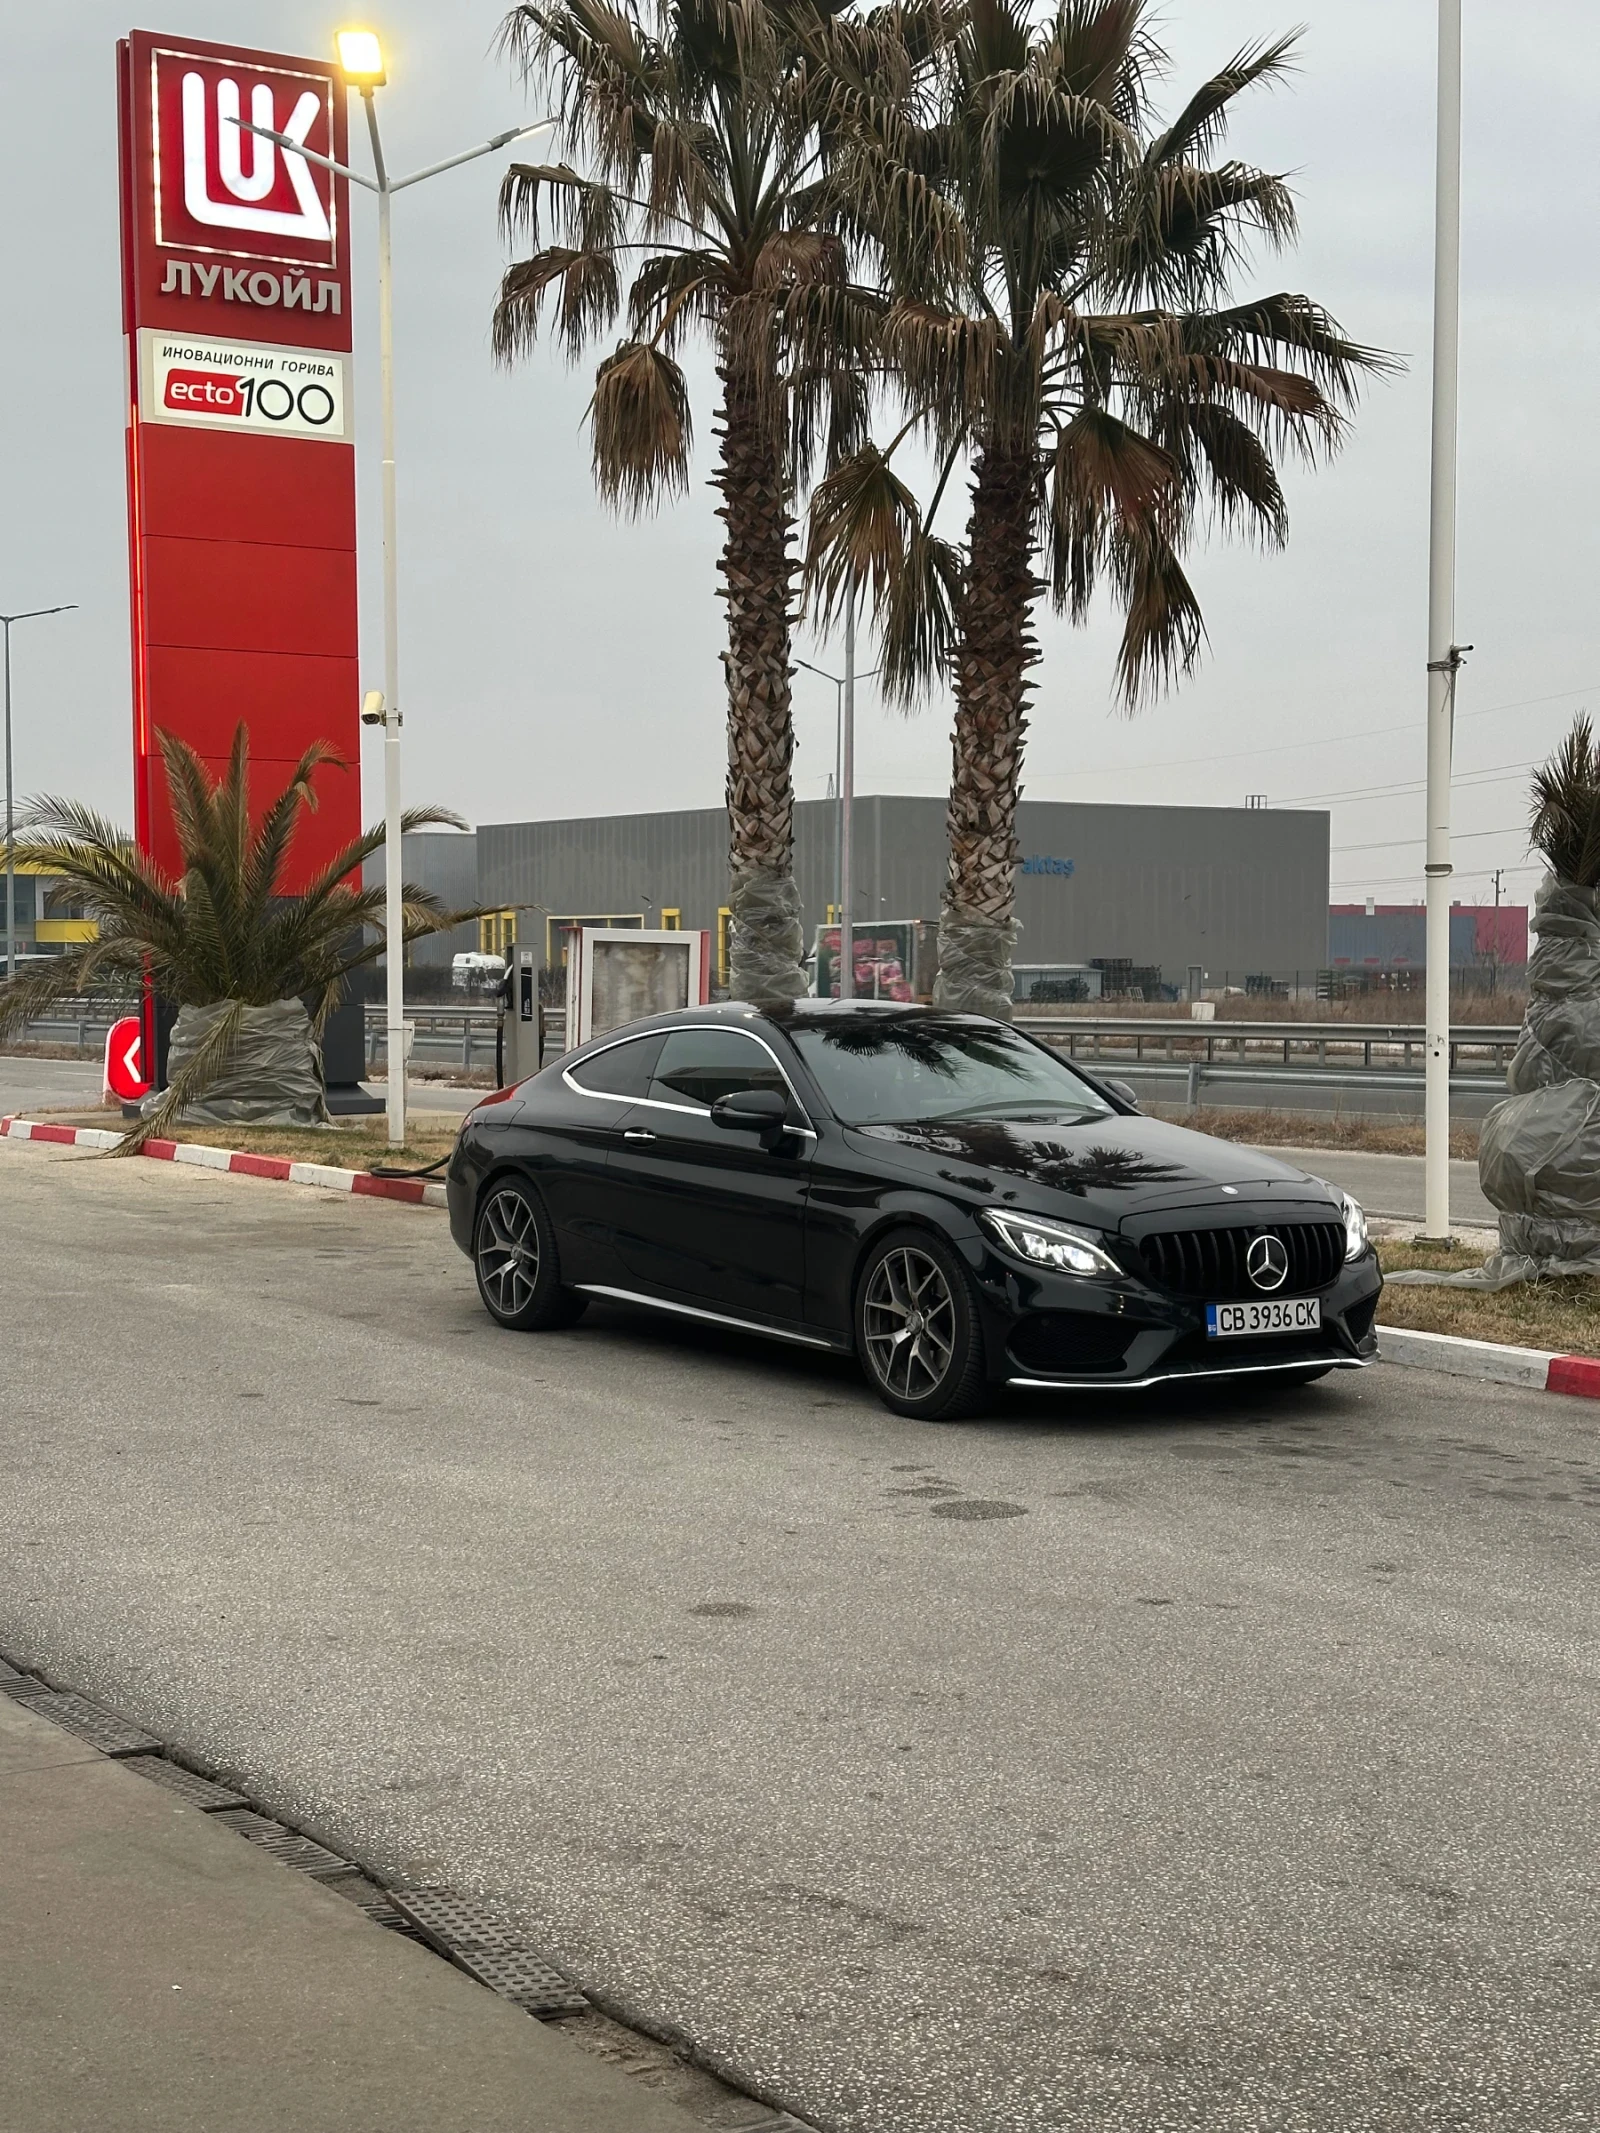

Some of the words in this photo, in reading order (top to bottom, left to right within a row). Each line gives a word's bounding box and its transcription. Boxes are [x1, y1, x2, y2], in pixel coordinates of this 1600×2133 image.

[160, 259, 342, 315] ЛУКОЙЛ
[162, 346, 274, 370] ИНОВАЦИОННИ
[281, 360, 334, 377] ГОРИВА
[1249, 1303, 1293, 1330] 3936
